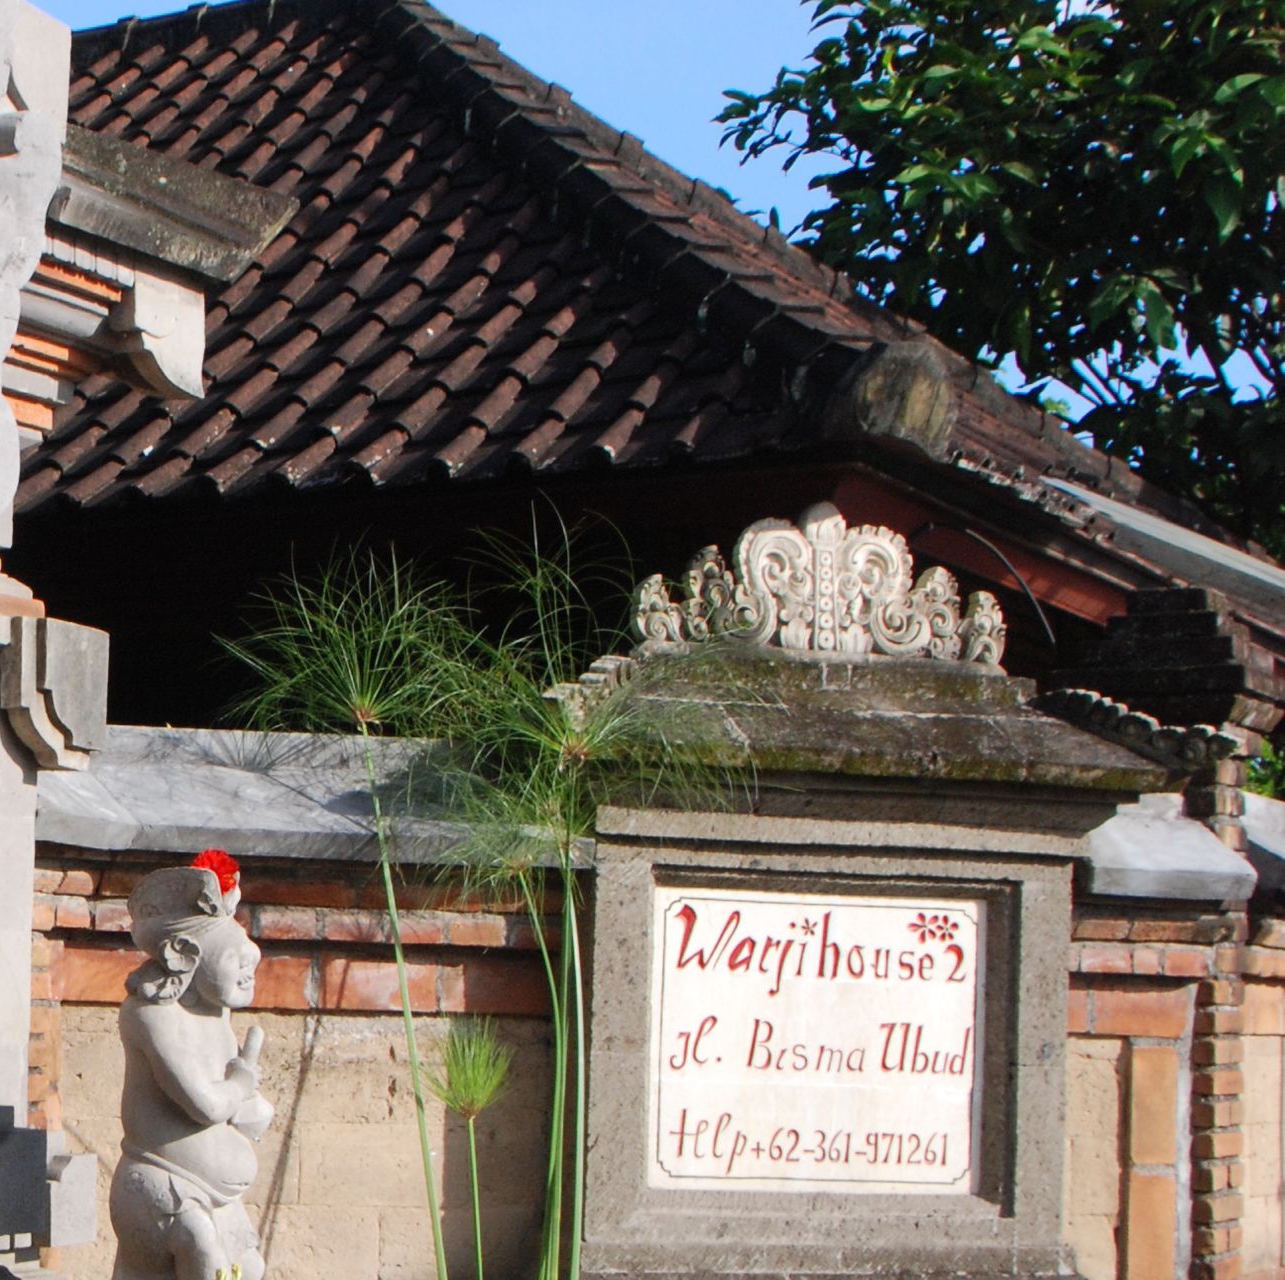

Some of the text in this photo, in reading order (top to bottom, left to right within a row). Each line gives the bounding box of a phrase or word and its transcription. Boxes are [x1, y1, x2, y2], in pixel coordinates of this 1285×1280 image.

[675, 903, 969, 997] Warji house 2
[746, 1018, 865, 1073] Bisma
[879, 1022, 972, 1075] Ubud
